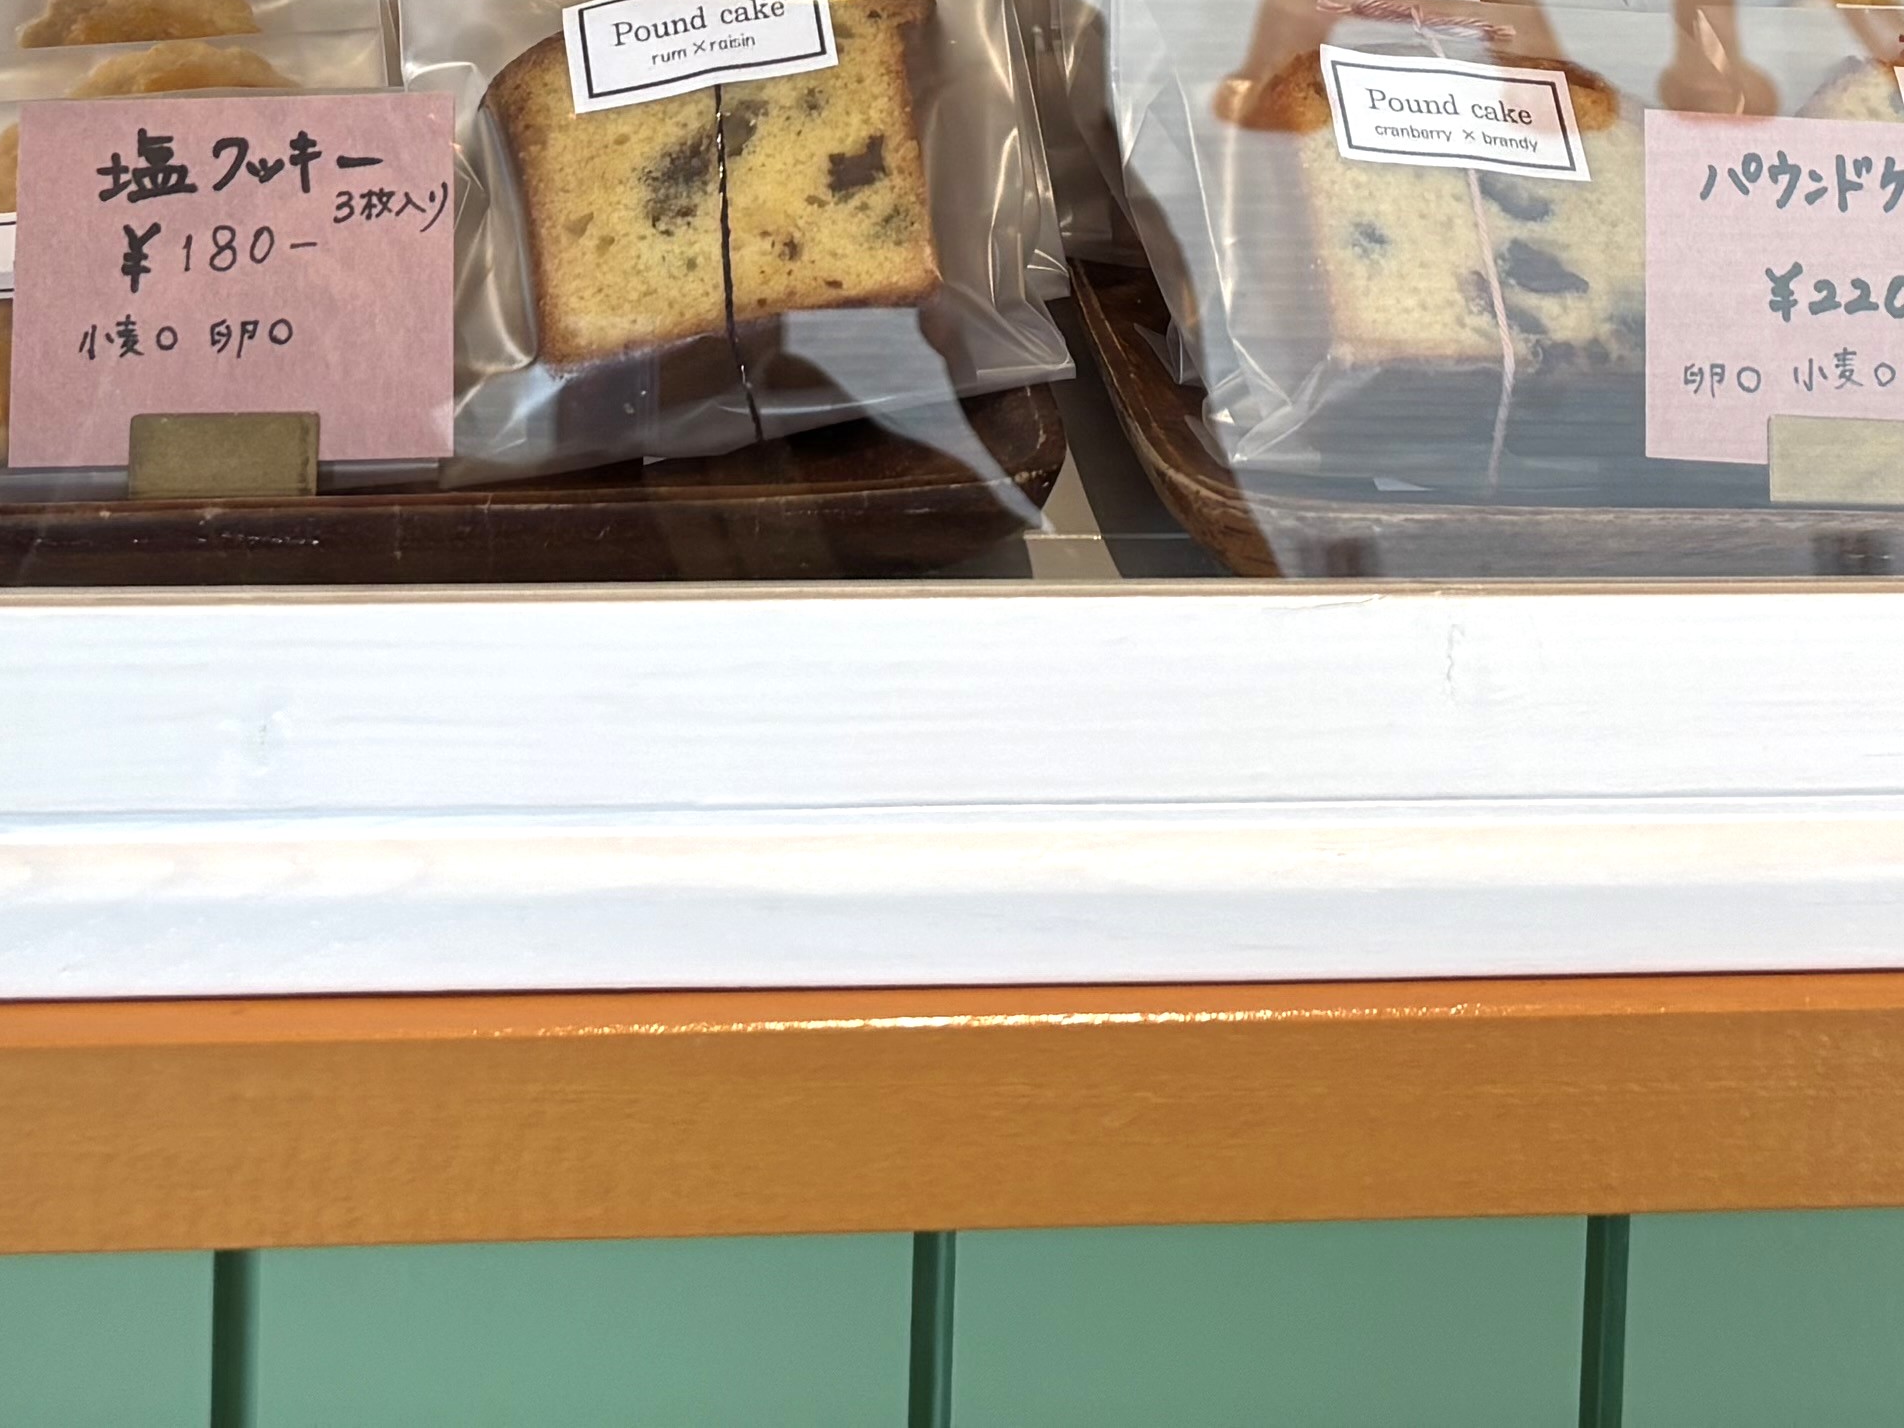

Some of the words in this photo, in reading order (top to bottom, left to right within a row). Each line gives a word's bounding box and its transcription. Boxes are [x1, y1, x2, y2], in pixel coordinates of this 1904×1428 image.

[611, 5, 708, 48] Pound
[650, 46, 688, 66] rum
[1364, 87, 1462, 117] Pound
[1470, 99, 1534, 127] cake
[1481, 130, 1539, 154] brandy
[95, 126, 385, 205] 塩クッキー
[332, 181, 449, 234] 3枚入り
